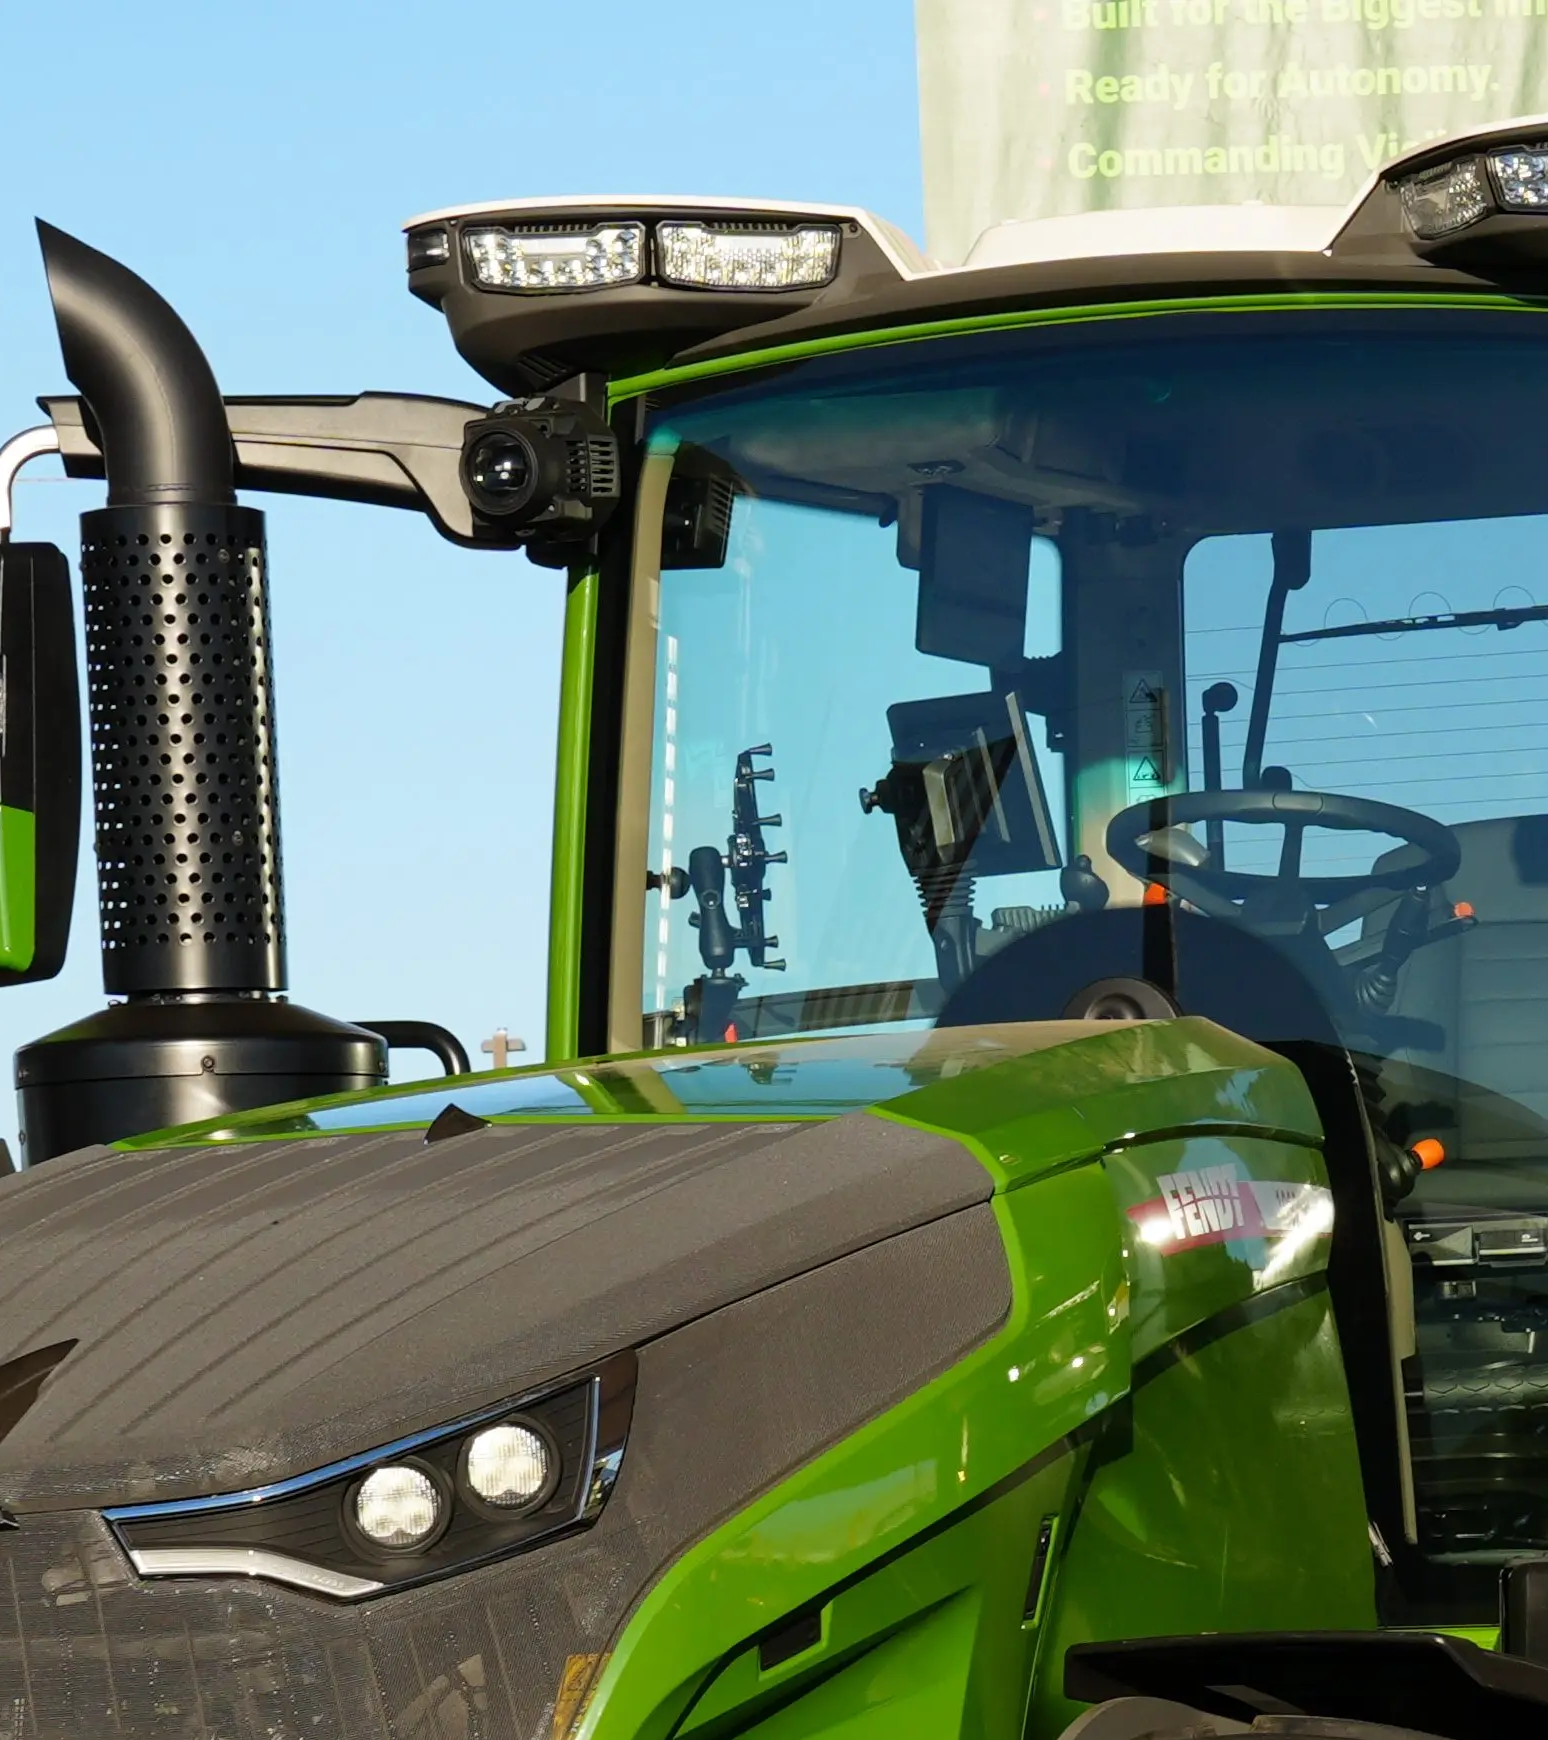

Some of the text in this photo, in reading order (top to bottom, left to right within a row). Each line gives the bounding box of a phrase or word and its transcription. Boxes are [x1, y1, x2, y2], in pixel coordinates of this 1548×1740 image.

[1063, 0, 1158, 30] Built
[1169, 0, 1226, 26] for
[1065, 59, 1500, 110] Ready for Autonomy.
[1067, 135, 1345, 180] Commanding
